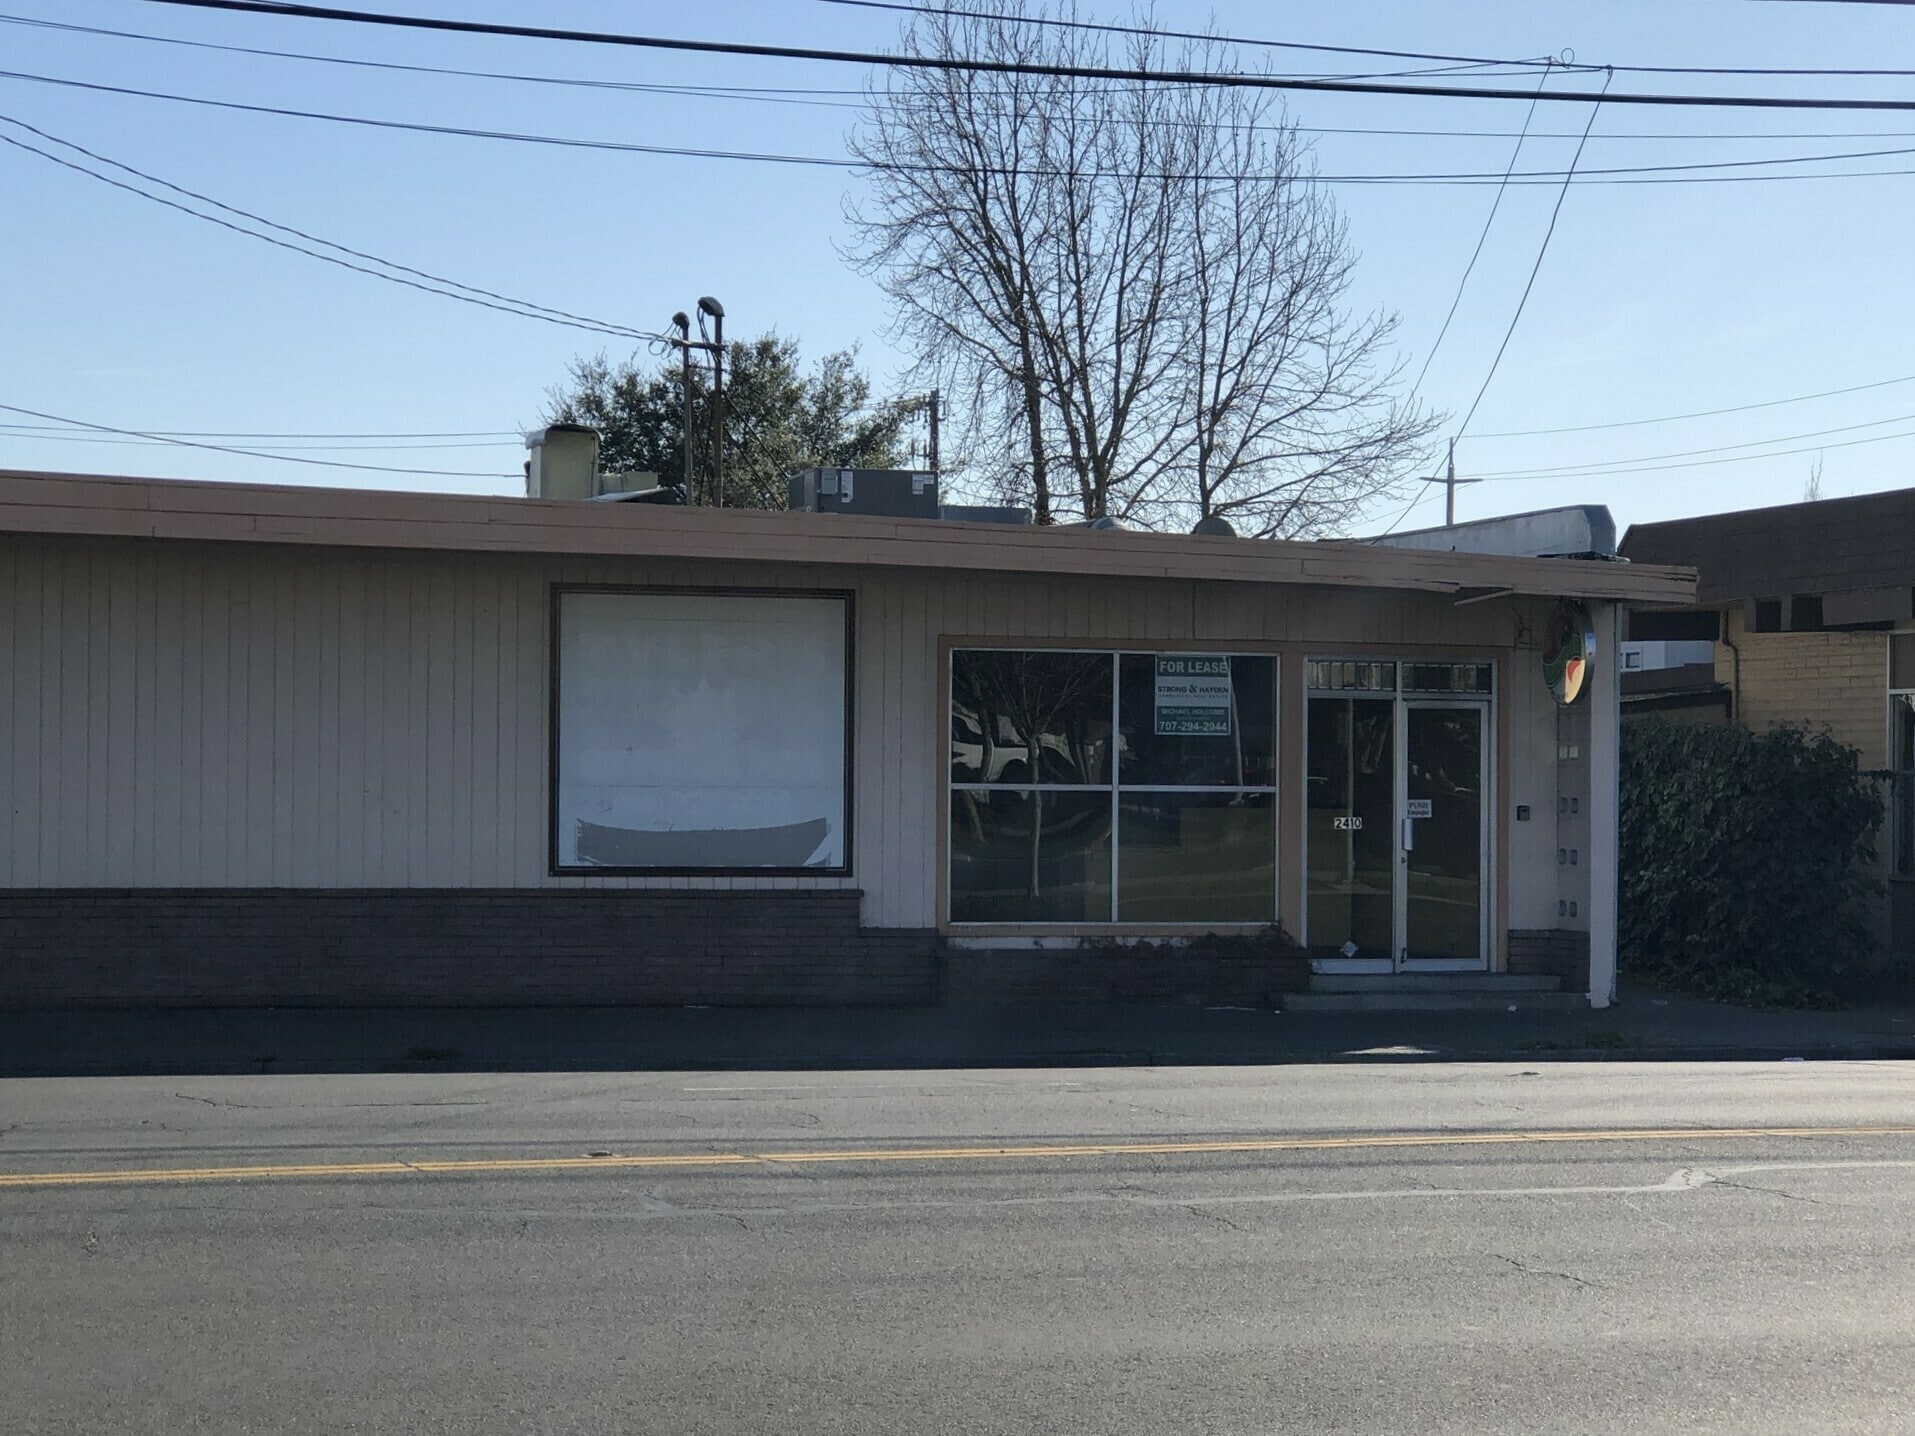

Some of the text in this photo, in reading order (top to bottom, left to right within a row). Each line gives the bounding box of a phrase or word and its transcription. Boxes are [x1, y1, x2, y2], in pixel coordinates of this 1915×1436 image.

[1160, 661, 1228, 673] FOR LEASE
[1188, 684, 1198, 693] &
[1335, 817, 1361, 829] 2410
